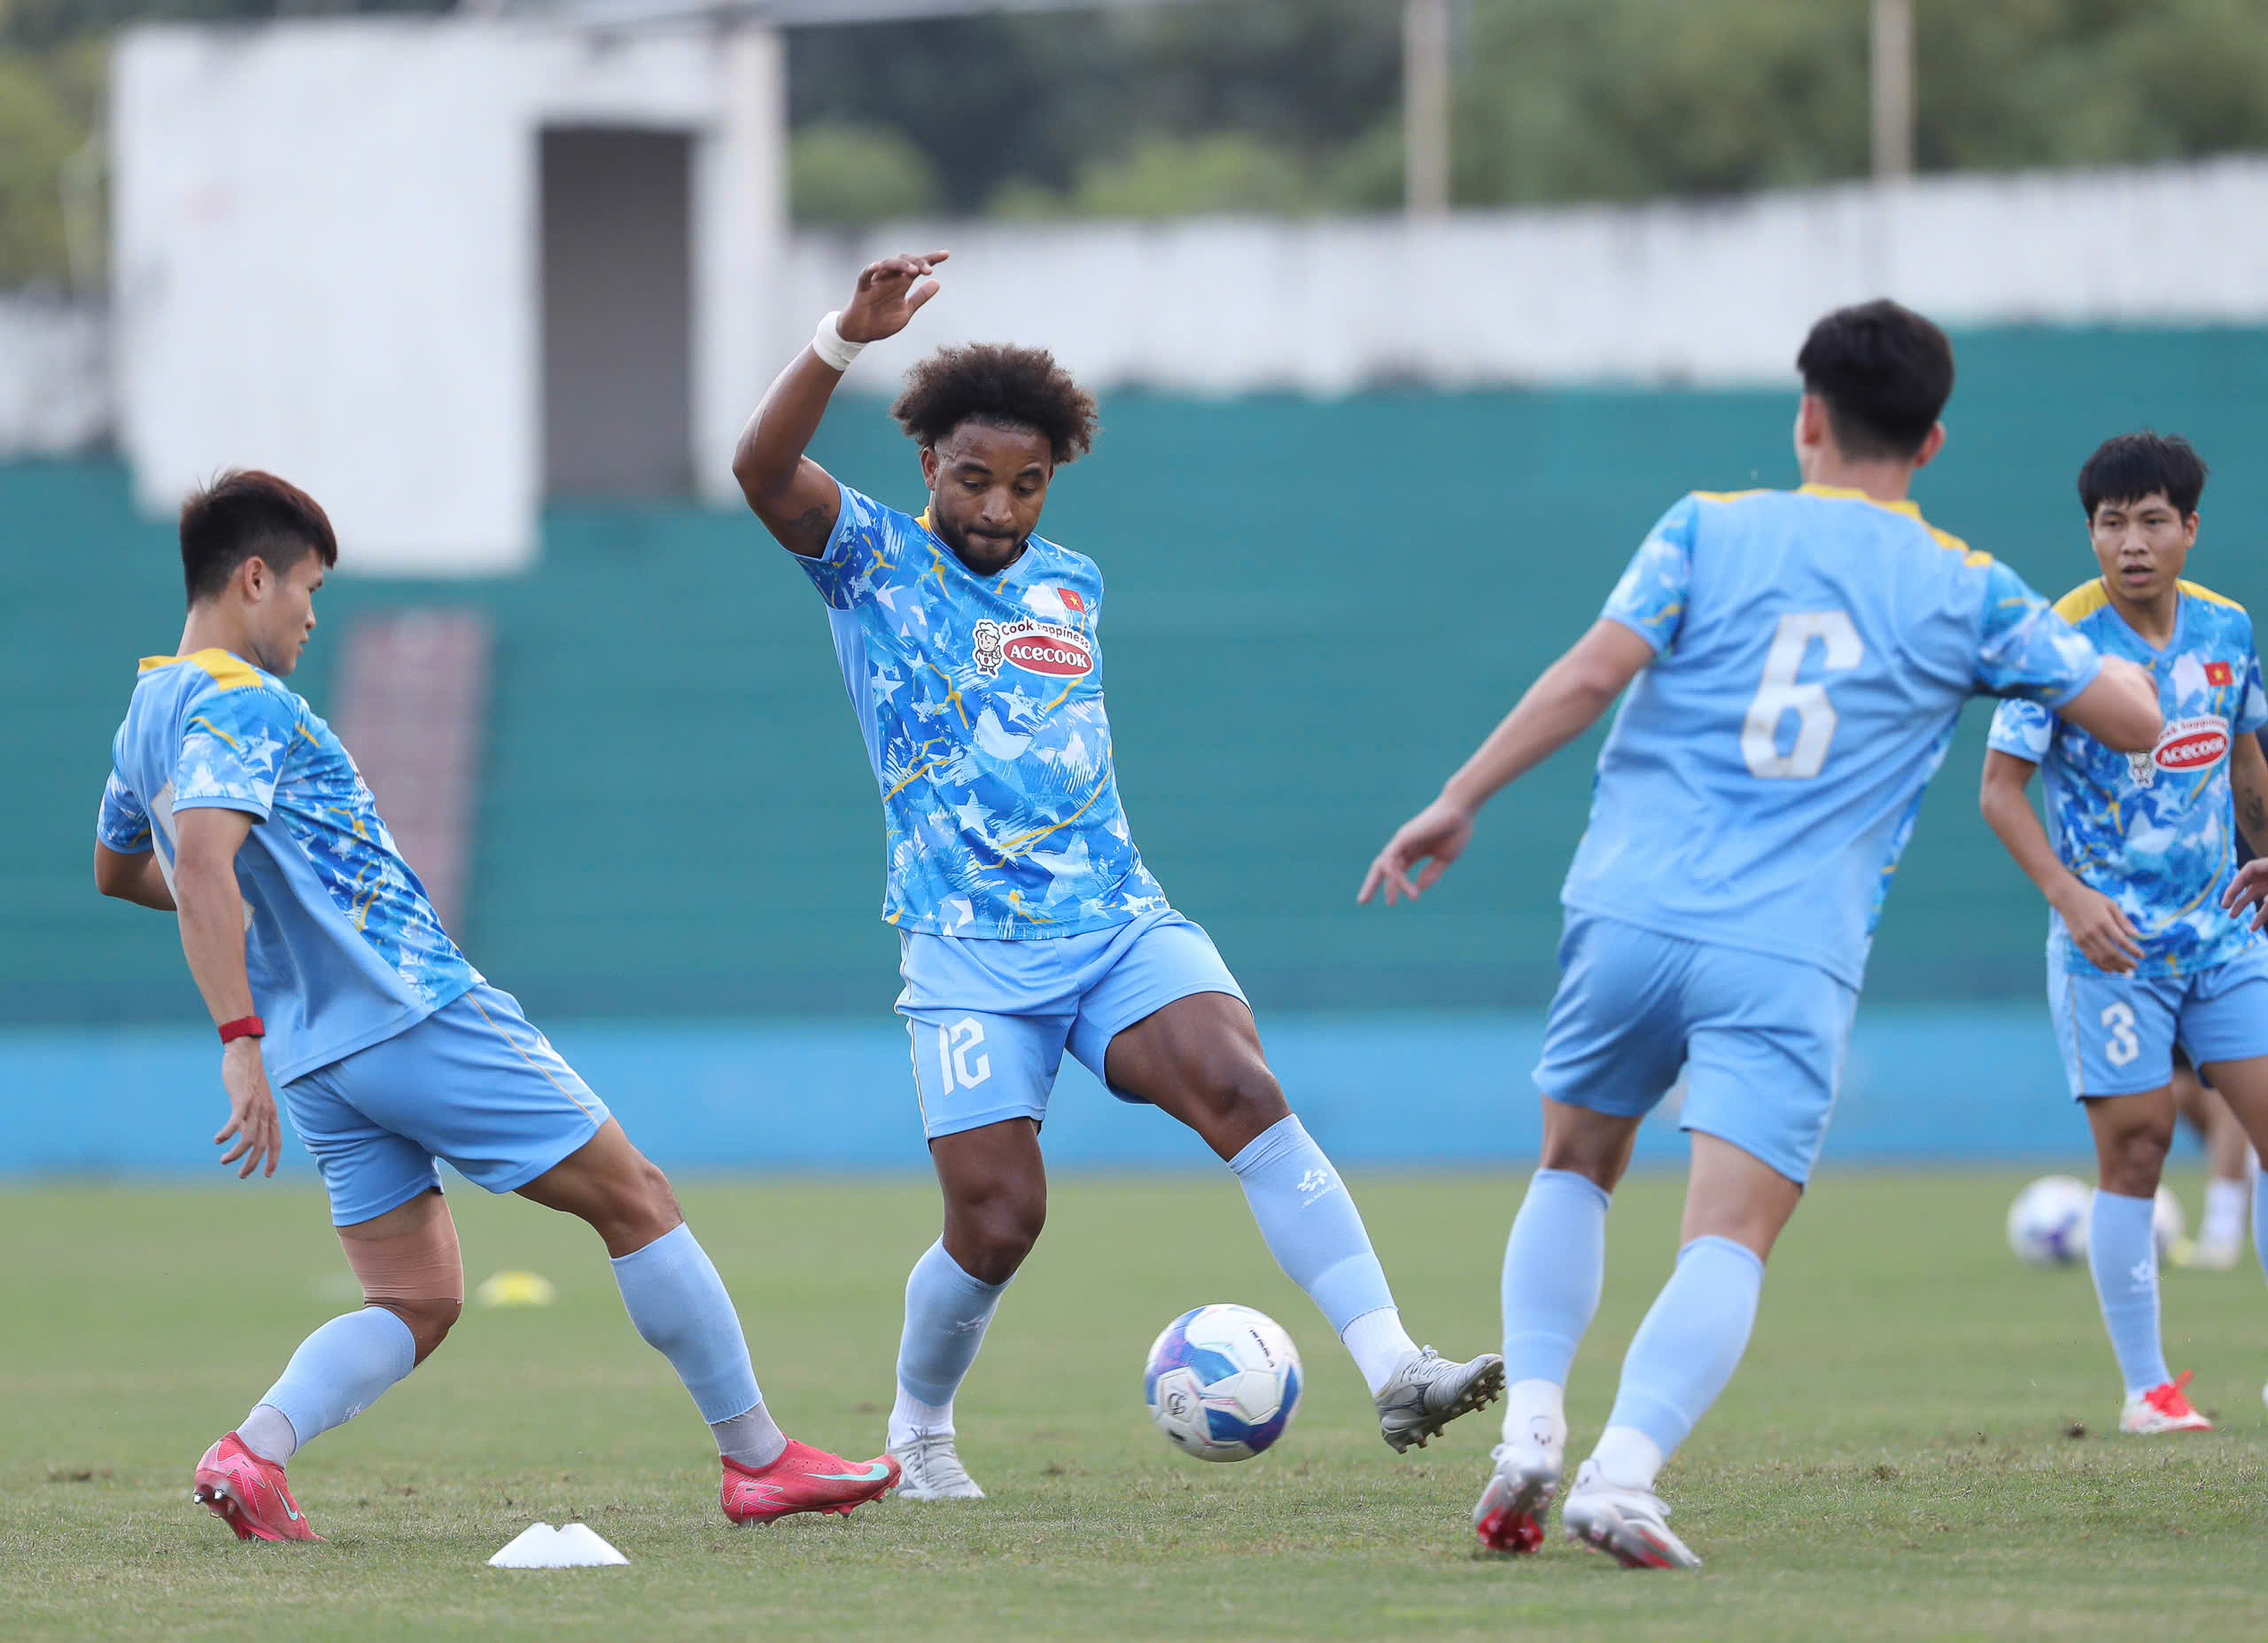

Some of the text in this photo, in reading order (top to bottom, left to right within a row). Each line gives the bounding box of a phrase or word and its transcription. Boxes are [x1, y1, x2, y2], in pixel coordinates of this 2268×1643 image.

[1002, 619, 1034, 635] Cook
[1741, 609, 1865, 779] 6
[939, 1016, 992, 1098] 12
[2101, 1001, 2140, 1066] 3
